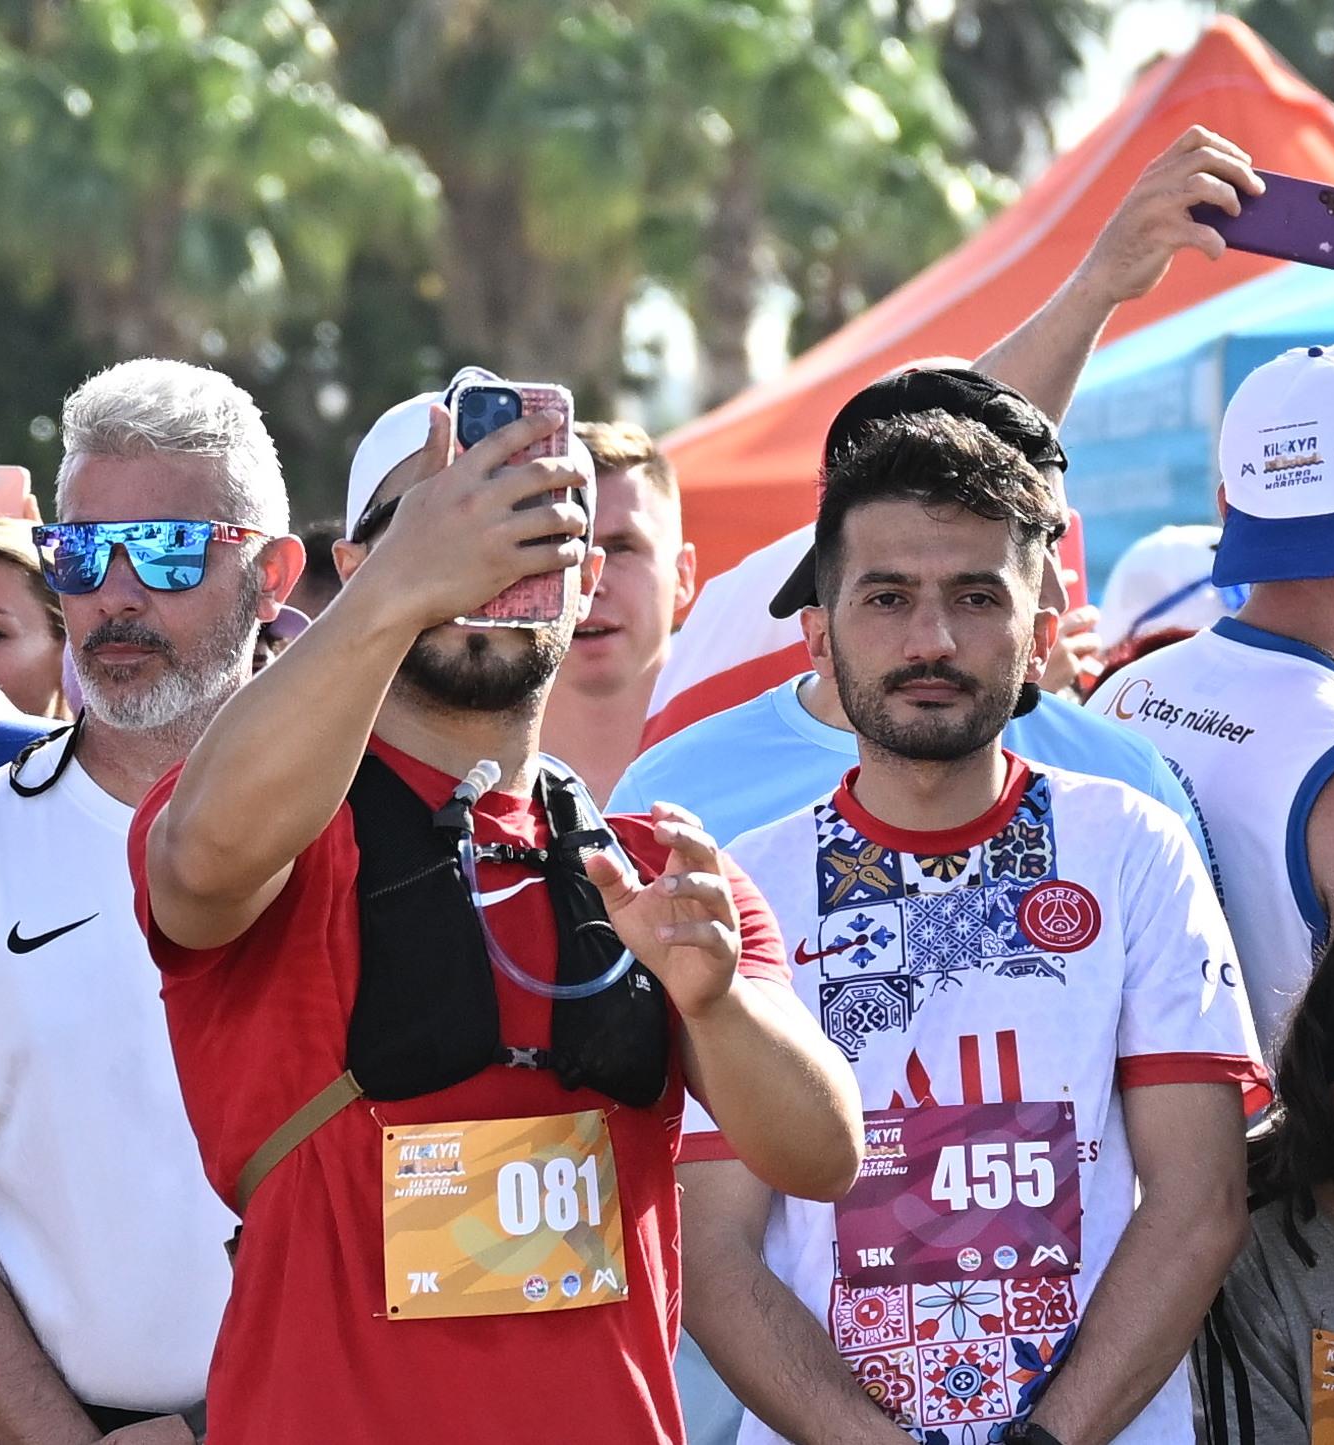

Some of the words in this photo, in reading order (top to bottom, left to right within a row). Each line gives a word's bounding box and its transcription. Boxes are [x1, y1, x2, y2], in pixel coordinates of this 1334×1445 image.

[1275, 469, 1311, 482] ULTRA
[1139, 691, 1183, 729] içtaş
[1181, 708, 1255, 744] nükleer
[1036, 889, 1082, 904] PARIS
[859, 1166, 909, 1178] RATONU
[931, 1141, 1056, 1211] 455
[395, 1185, 468, 1197] MARATONU
[409, 1178, 452, 1189] ULTRA
[497, 1154, 601, 1236] 081
[857, 1247, 895, 1268] 15K
[407, 1272, 440, 1294] 7K
